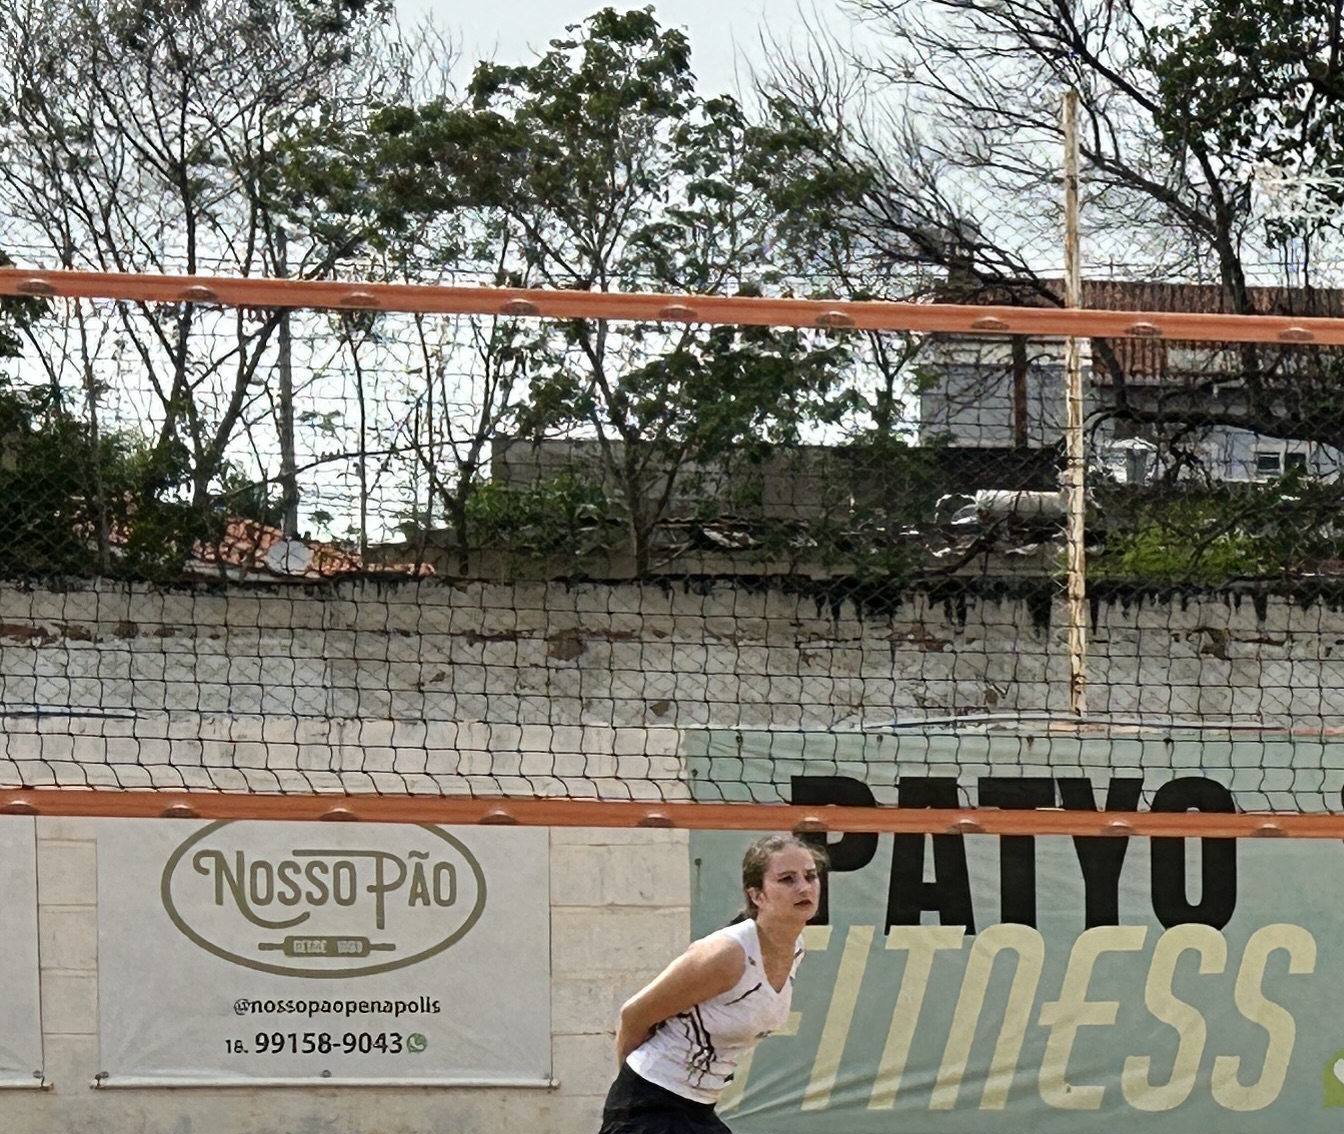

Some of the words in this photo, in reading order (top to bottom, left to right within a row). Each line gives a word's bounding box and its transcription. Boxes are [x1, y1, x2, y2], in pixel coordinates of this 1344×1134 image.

[791, 776, 1237, 935] PATYO
[193, 850, 358, 928] NOSSO
[292, 850, 456, 929] PÃO
[233, 996, 441, 1017] @nossopaopenapolis
[225, 1040, 248, 1054] 18.
[255, 1032, 403, 1054] 99158-9043
